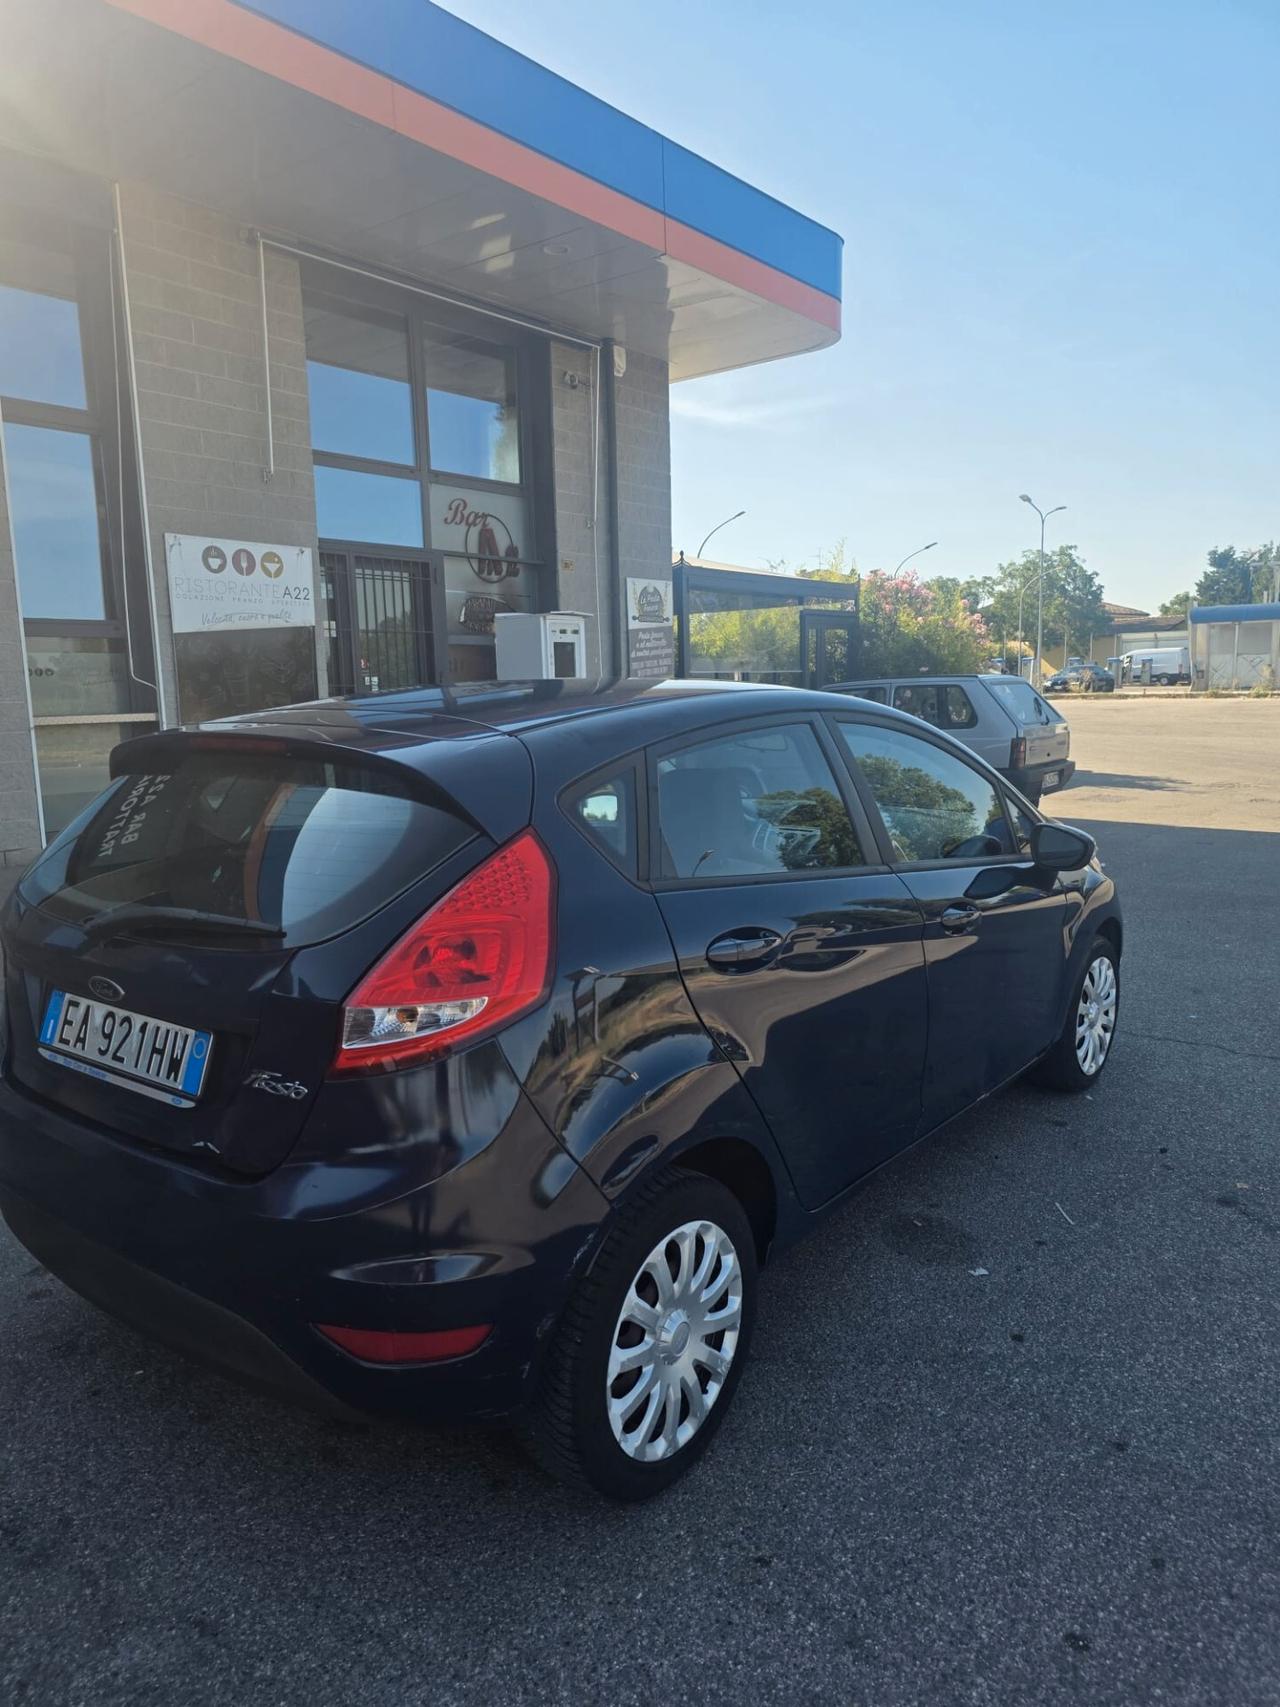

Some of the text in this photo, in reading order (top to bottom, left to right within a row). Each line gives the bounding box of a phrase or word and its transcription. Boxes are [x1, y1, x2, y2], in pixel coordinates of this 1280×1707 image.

[444, 498, 489, 528] Bar
[174, 576, 310, 600] RISTORANTE A22
[58, 999, 91, 1051] EA
